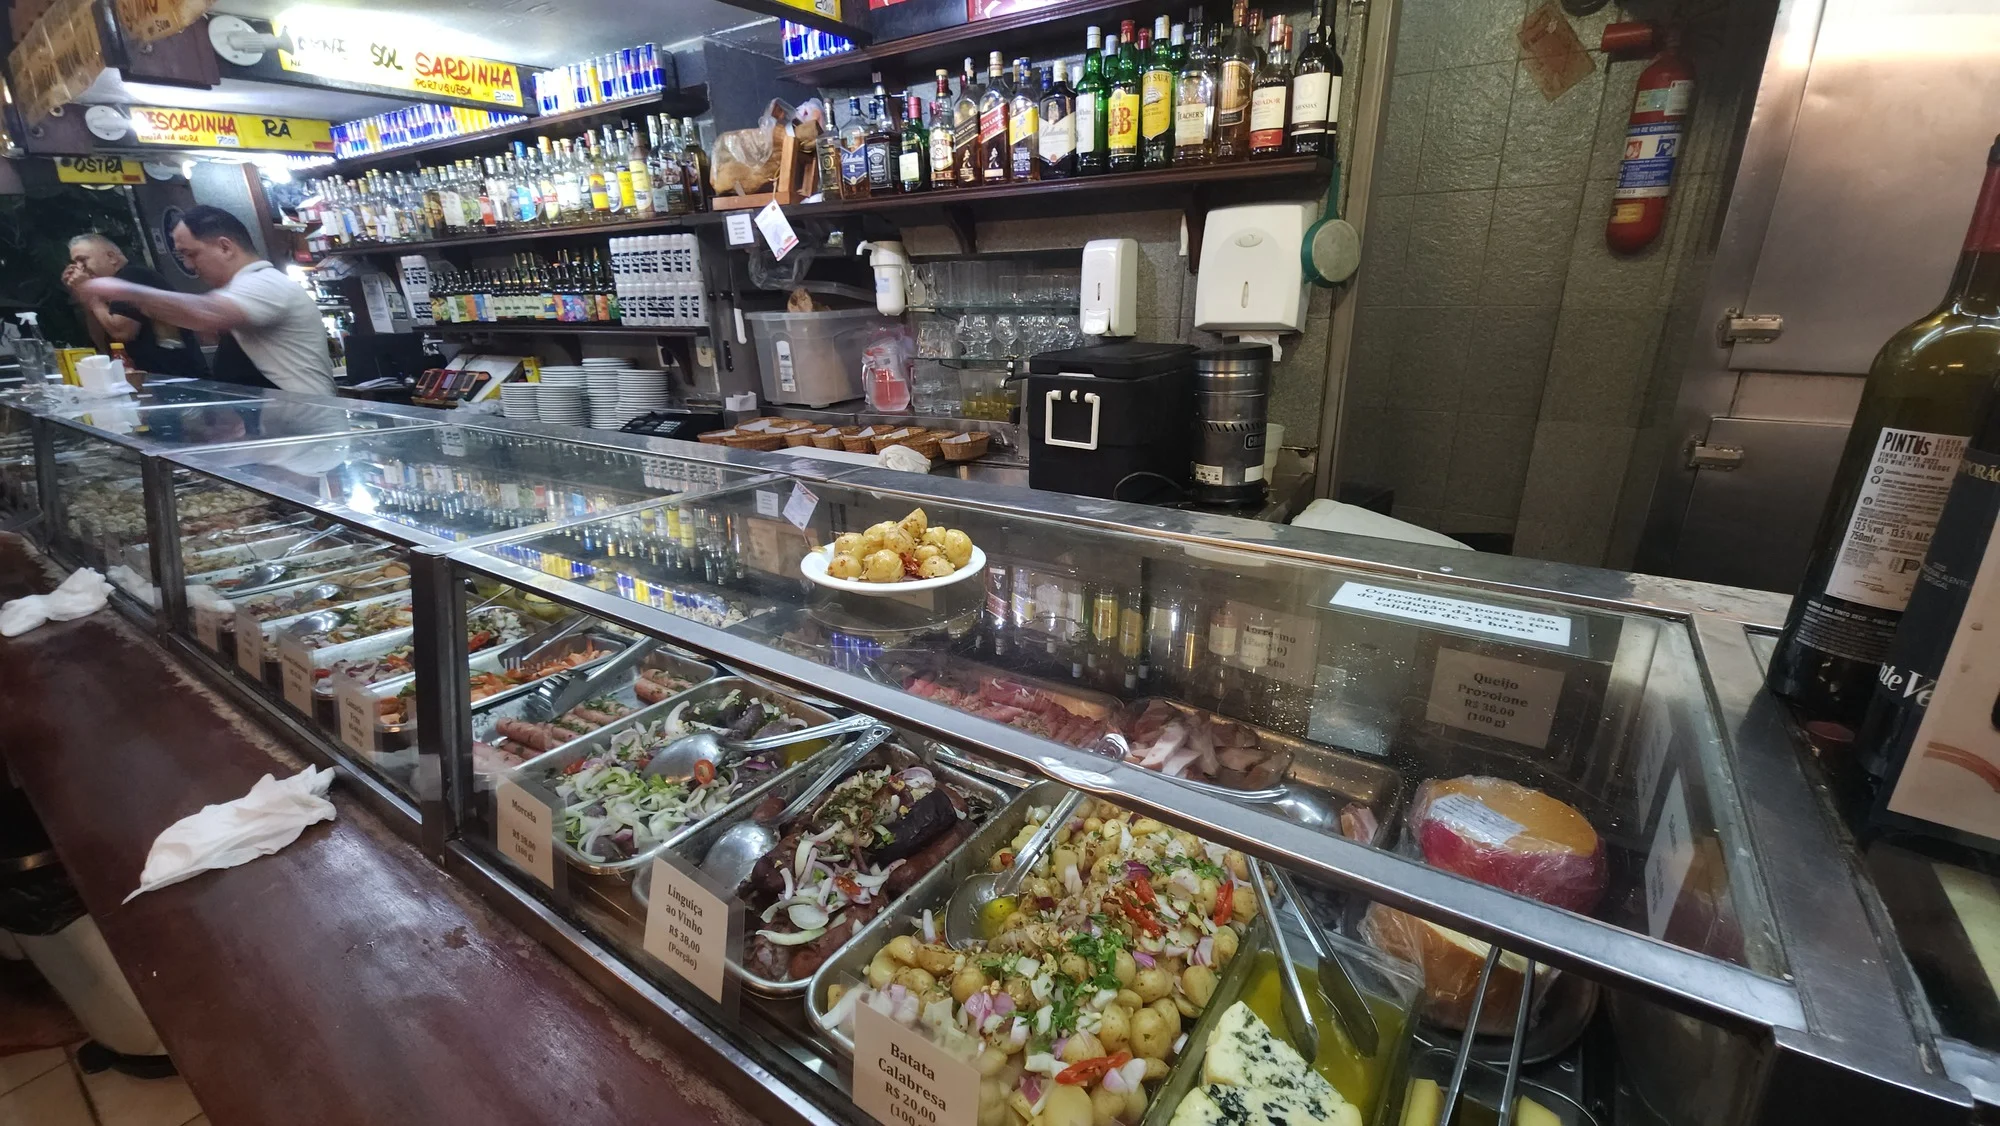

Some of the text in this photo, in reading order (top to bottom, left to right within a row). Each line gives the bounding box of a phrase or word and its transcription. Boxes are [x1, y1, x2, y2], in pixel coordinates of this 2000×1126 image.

[414, 51, 514, 91] SARDINHA
[414, 78, 473, 97] PORTUGUESA
[140, 110, 238, 136] ESCADINHA
[263, 119, 292, 139] RÃ
[74, 156, 124, 174] OSTRA
[1374, 601, 1436, 616] validade
[1464, 616, 1482, 624] 24
[1488, 621, 1535, 634] horas
[1377, 596, 1447, 612] produção
[1452, 608, 1470, 616] da
[1475, 613, 1509, 623] casa
[1528, 623, 1560, 632] tem
[1387, 593, 1453, 607] produtos
[1457, 604, 1524, 619] expostos
[1528, 616, 1556, 625] são
[1457, 683, 1529, 708] Provolone
[1473, 672, 1519, 690] Queijo
[1464, 698, 1479, 709] R$
[1467, 711, 1506, 729] (100 g)
[511, 798, 537, 825] Morcela
[667, 883, 703, 918] Linguiça
[665, 904, 703, 936] ao Vinho
[668, 924, 701, 954] R$ 38,00
[668, 941, 698, 971] (Porção)
[890, 1041, 936, 1082] Batata
[878, 1057, 947, 1113] Calabresa
[885, 1081, 937, 1124] R$ 20,00
[890, 1103, 915, 1126] (100
